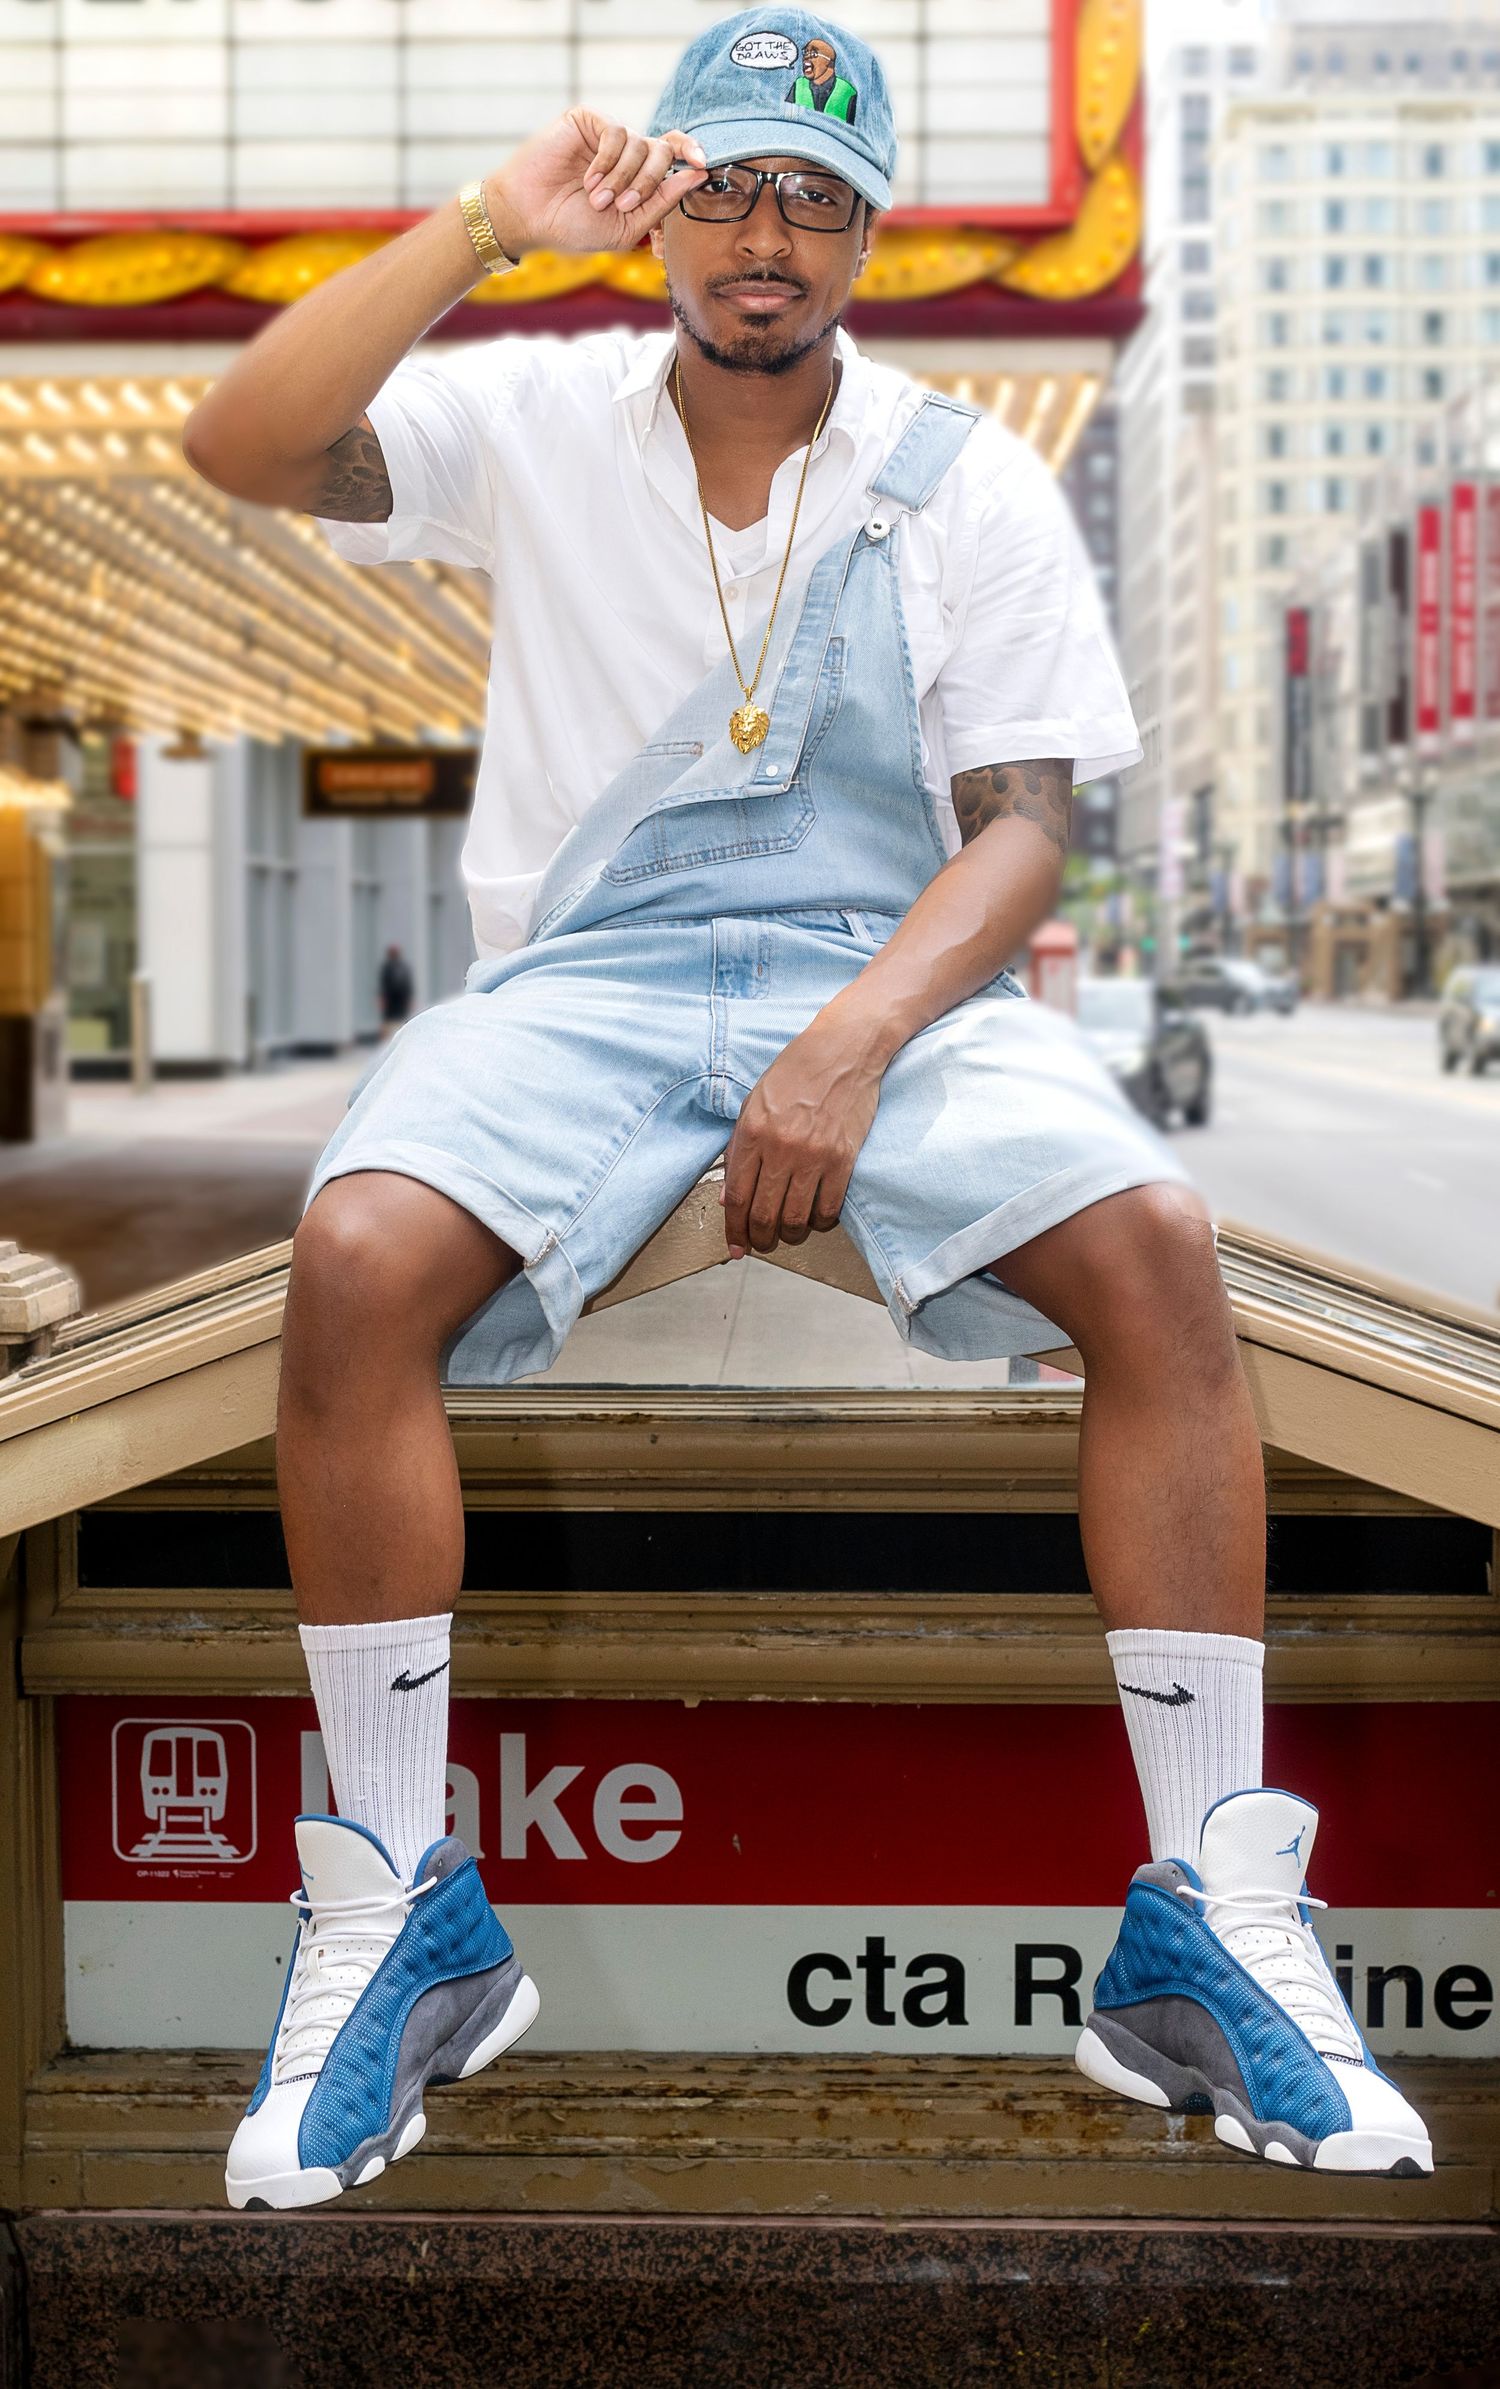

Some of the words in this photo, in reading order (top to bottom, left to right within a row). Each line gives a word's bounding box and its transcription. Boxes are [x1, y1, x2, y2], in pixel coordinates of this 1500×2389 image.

[735, 41, 761, 51] GOT
[765, 41, 793, 50] THE
[787, 1936, 969, 2028] cta
[1336, 1944, 1494, 2031] ine
